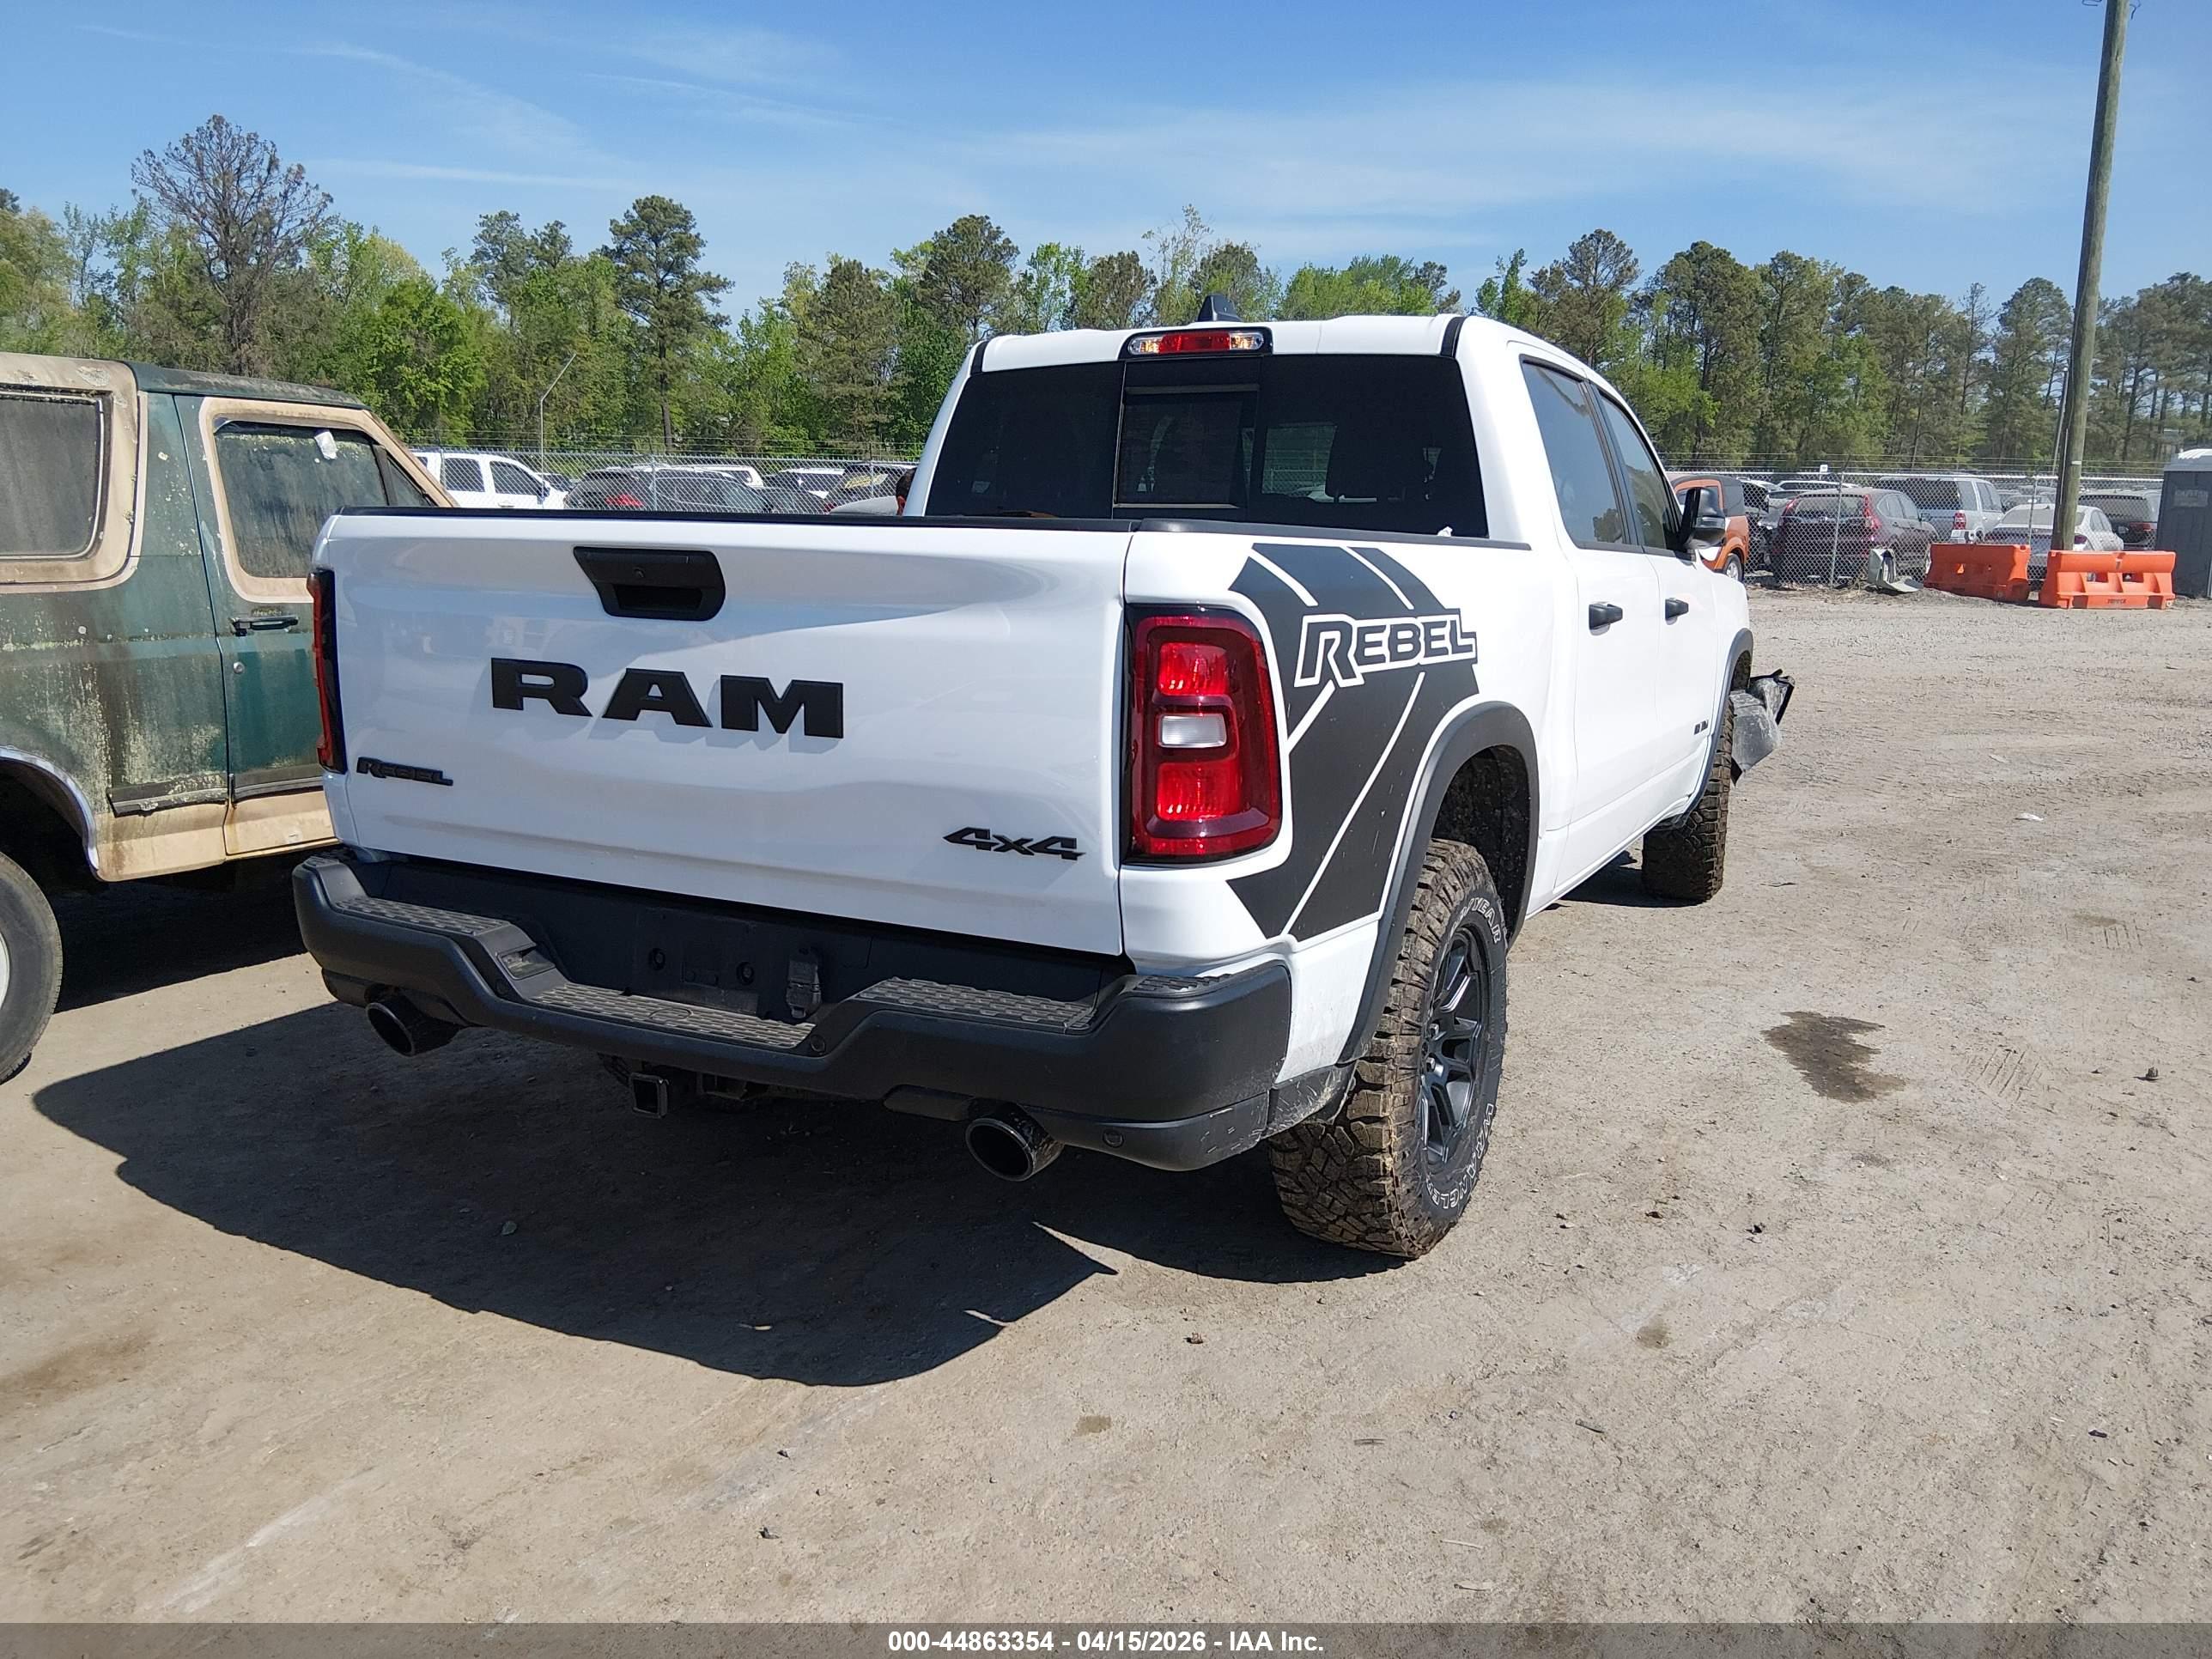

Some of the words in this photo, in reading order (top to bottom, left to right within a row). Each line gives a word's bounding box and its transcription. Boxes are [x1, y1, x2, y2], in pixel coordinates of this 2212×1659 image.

[1294, 613, 1477, 688] REBEL
[490, 657, 844, 739] RAM
[356, 757, 454, 787] REBEL
[1449, 897, 1502, 945] DYEAR
